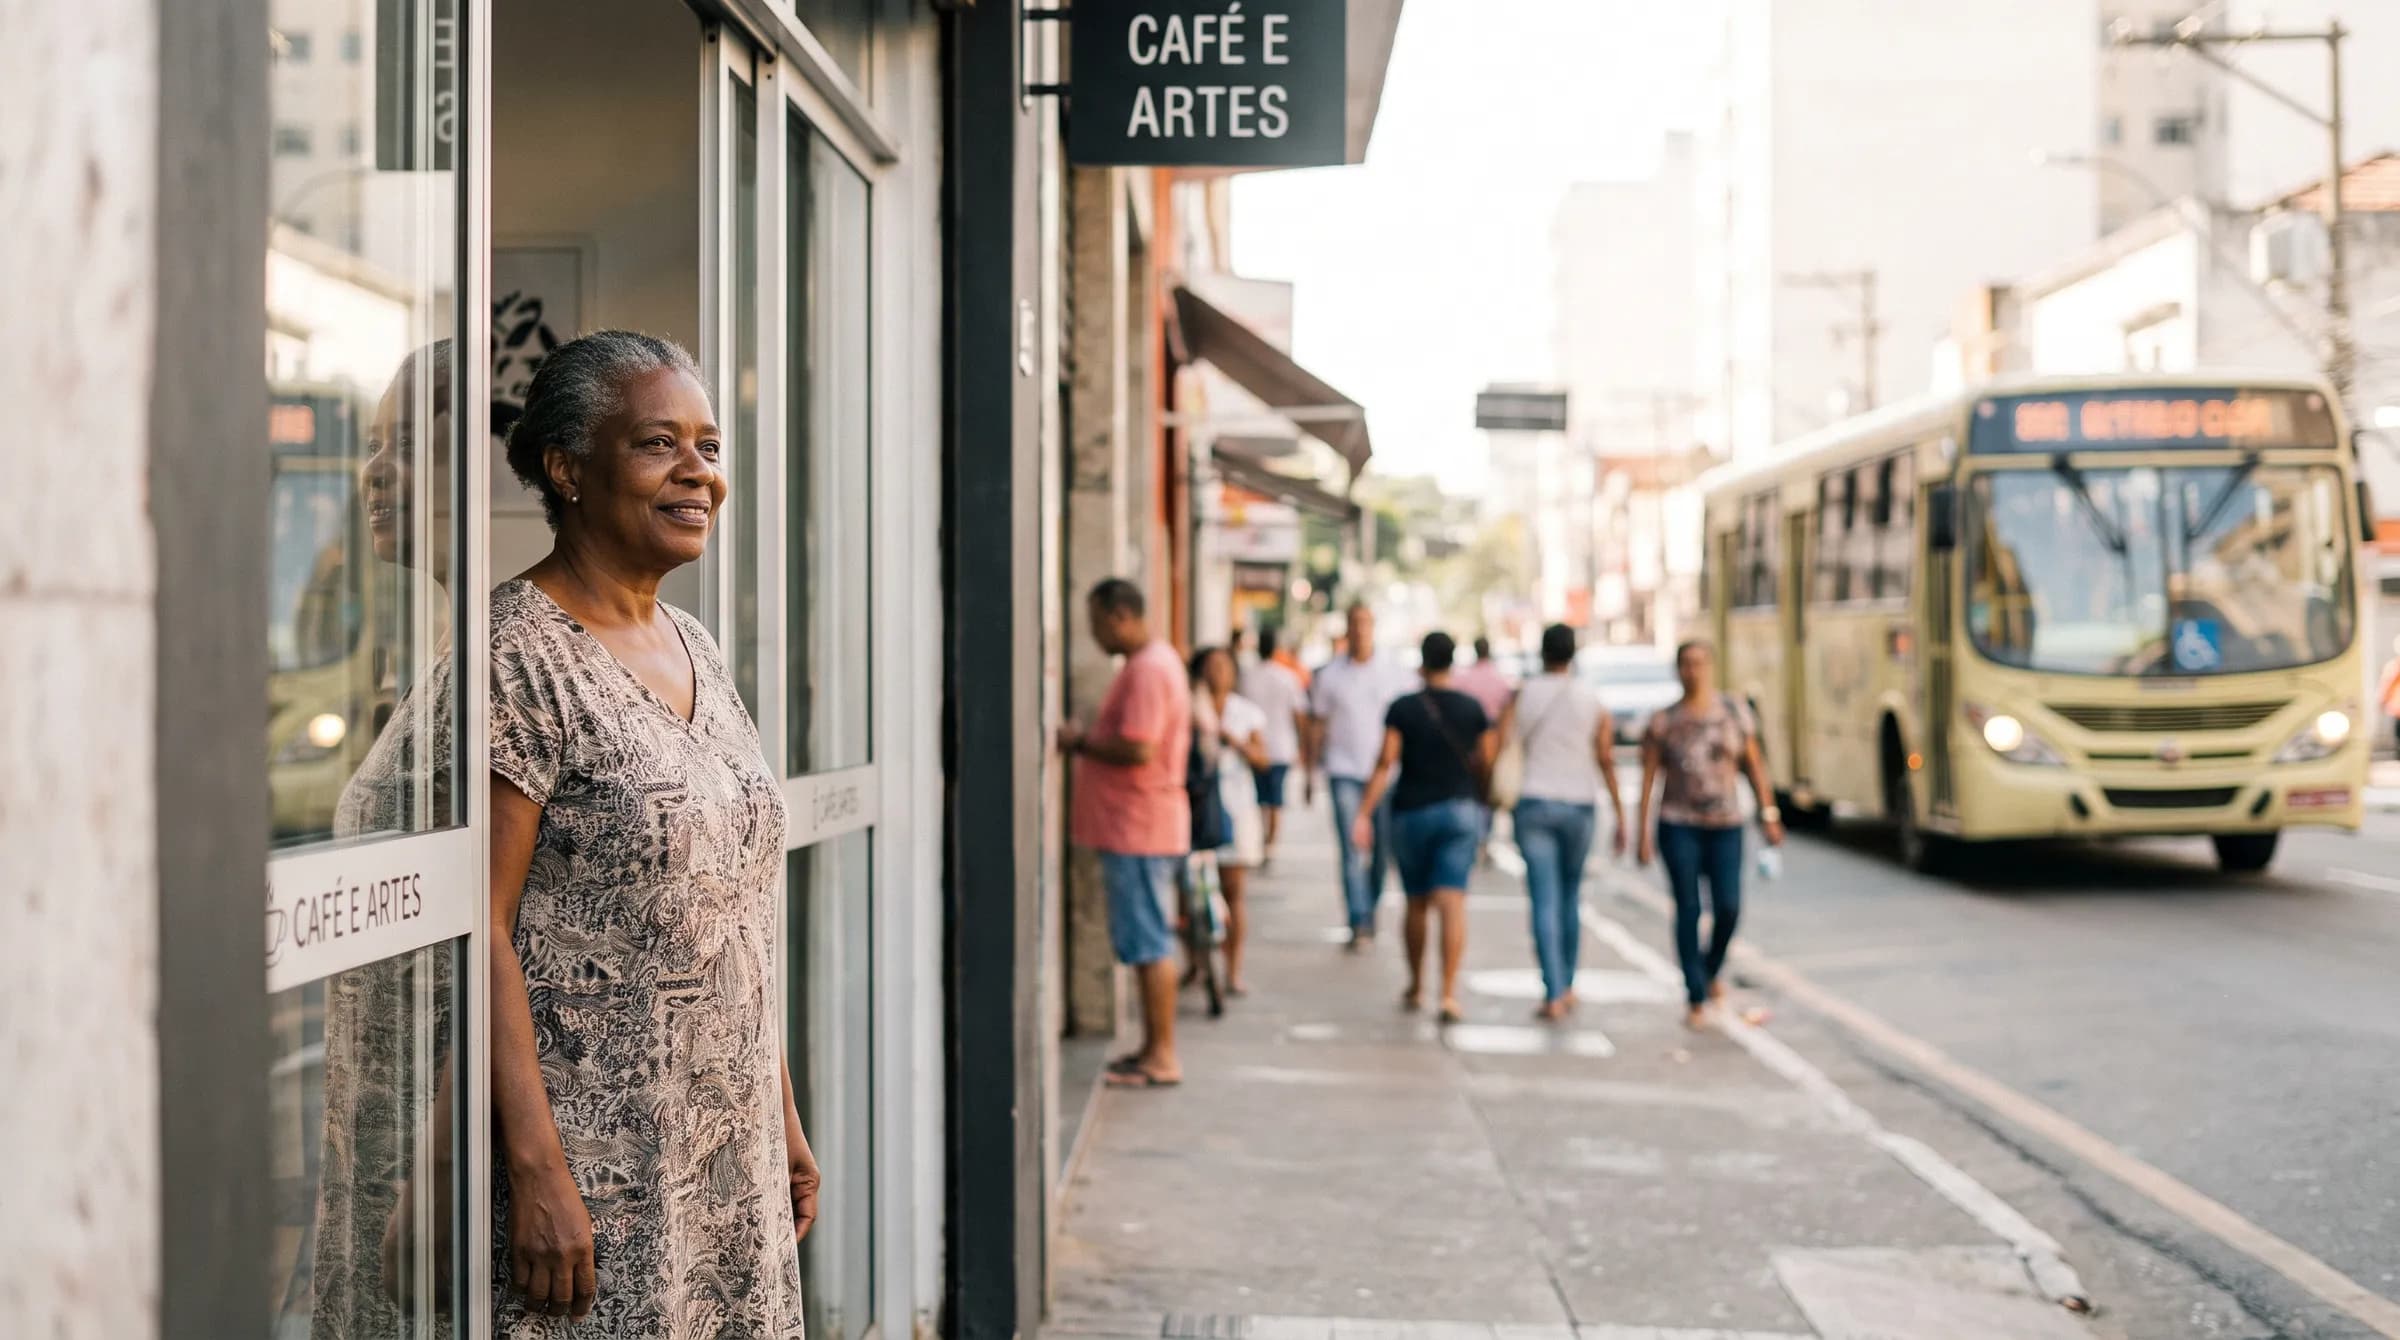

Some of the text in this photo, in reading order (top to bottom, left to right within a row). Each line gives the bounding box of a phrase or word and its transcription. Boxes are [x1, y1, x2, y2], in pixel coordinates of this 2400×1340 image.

[1127, 1, 1290, 66] CAFÉ E
[1126, 85, 1290, 138] ARTES
[294, 872, 422, 948] CAFÉ E ARTES
